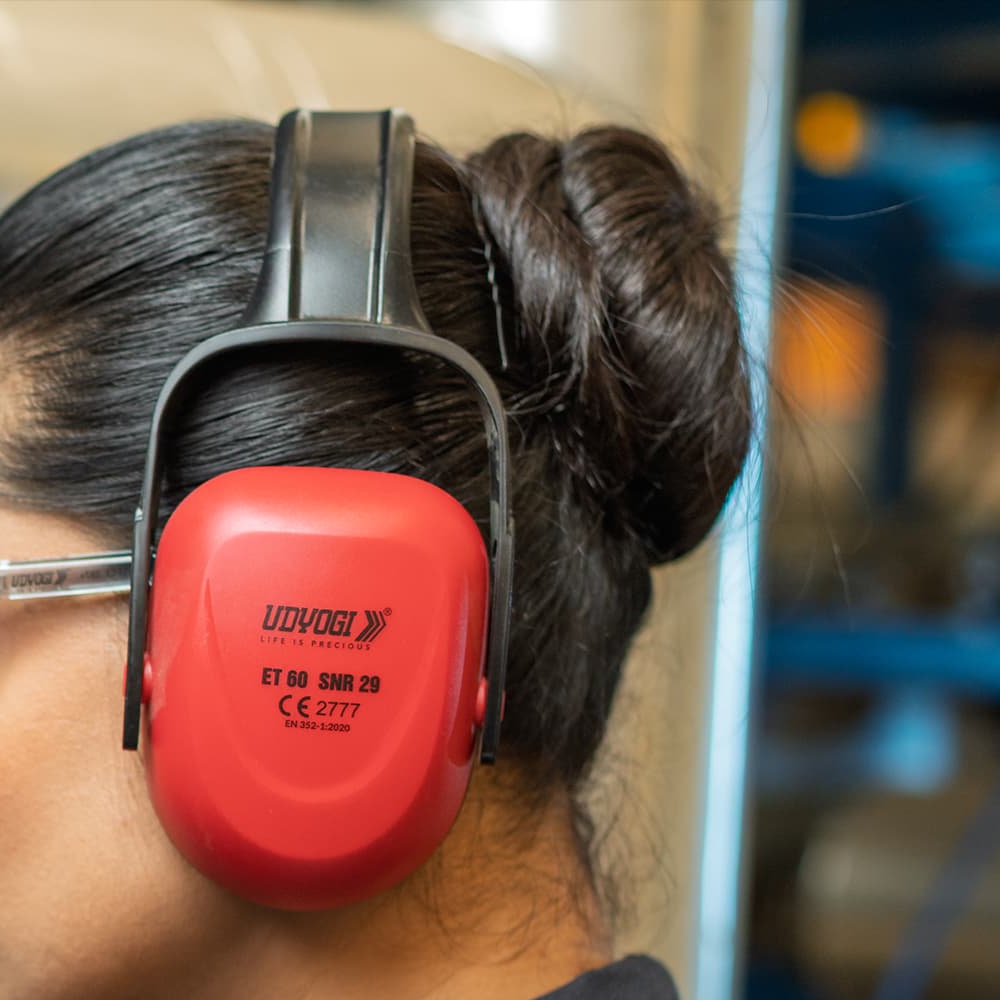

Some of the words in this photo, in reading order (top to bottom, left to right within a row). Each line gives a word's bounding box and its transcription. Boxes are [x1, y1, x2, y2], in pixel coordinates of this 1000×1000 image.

[262, 604, 357, 637] UDYOGI
[260, 636, 286, 645] LIFE
[311, 640, 371, 651] PRECIOUS
[261, 667, 282, 686] ET
[287, 670, 308, 688] 60
[318, 672, 354, 692] SNR
[359, 675, 381, 694] 29
[316, 700, 361, 718] 2777
[285, 719, 298, 729] EN
[300, 721, 350, 733] 352-1:2020
